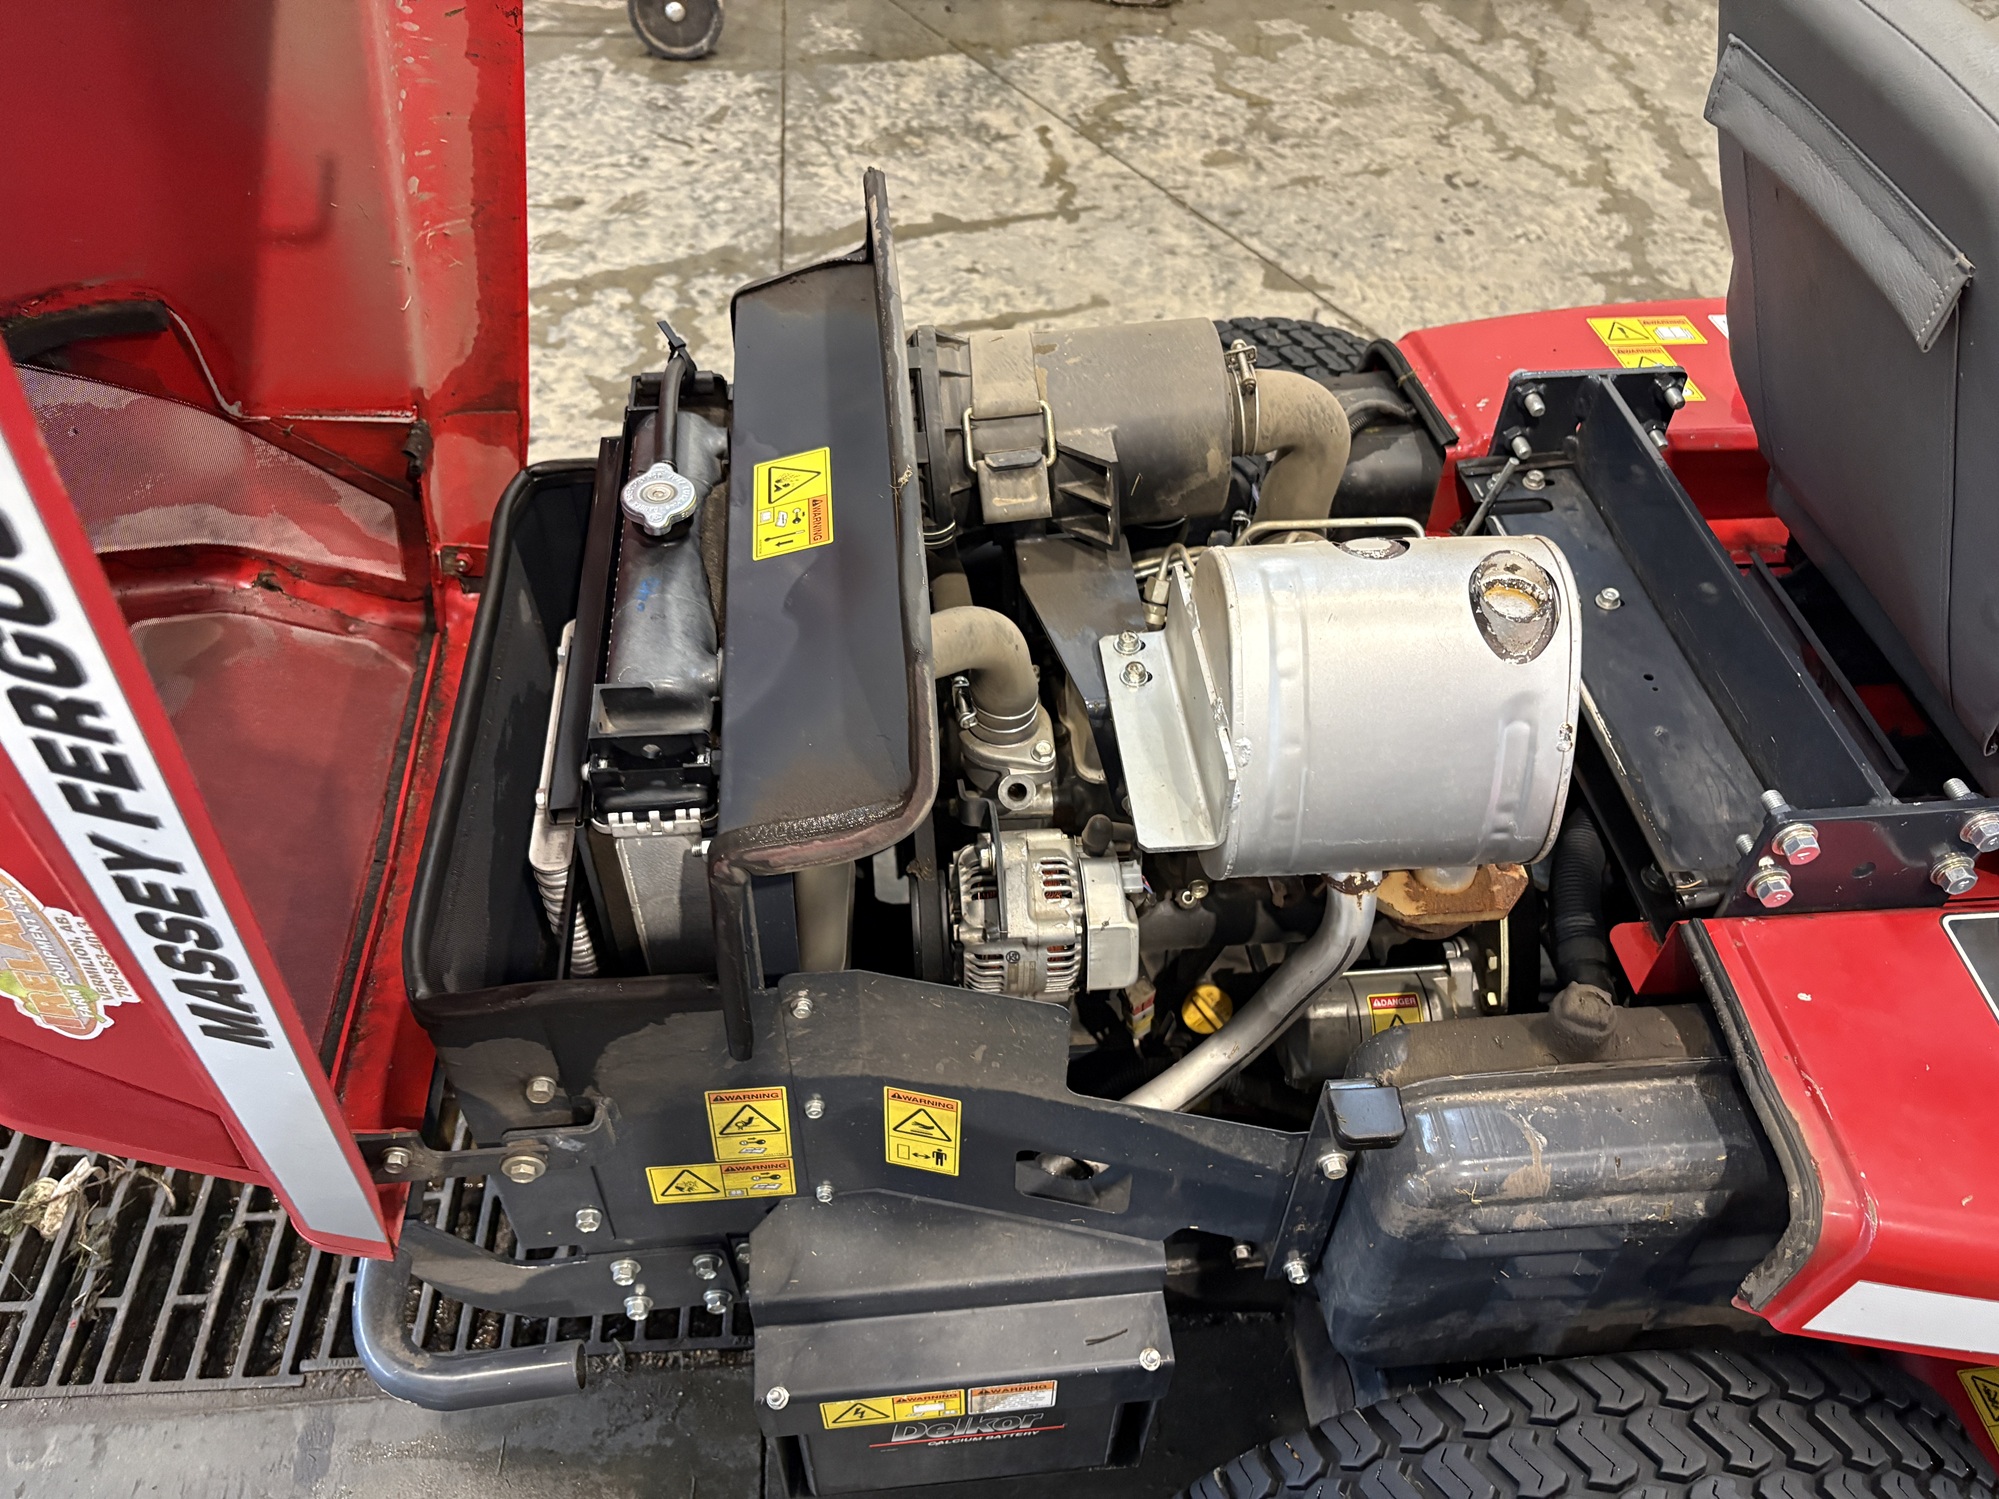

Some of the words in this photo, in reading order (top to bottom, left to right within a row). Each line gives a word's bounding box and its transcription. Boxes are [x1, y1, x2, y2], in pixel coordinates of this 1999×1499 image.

[812, 506, 823, 542] WARNING
[86, 831, 275, 1050] MASSEY
[21, 915, 76, 987] EQUIPMENT
[67, 937, 114, 1001] VERMILION,
[67, 989, 95, 1018] FARM
[1381, 997, 1416, 1007] DANGER
[724, 1092, 780, 1101] WARNING
[902, 1095, 954, 1110] WARNING
[735, 1163, 787, 1171] WARNING
[906, 1392, 958, 1402] WARNING
[991, 1384, 1047, 1395] WARNING
[891, 1412, 1045, 1442] Delkor
[928, 1436, 983, 1447] CALCIUM
[985, 1430, 1040, 1441] BATTERY
